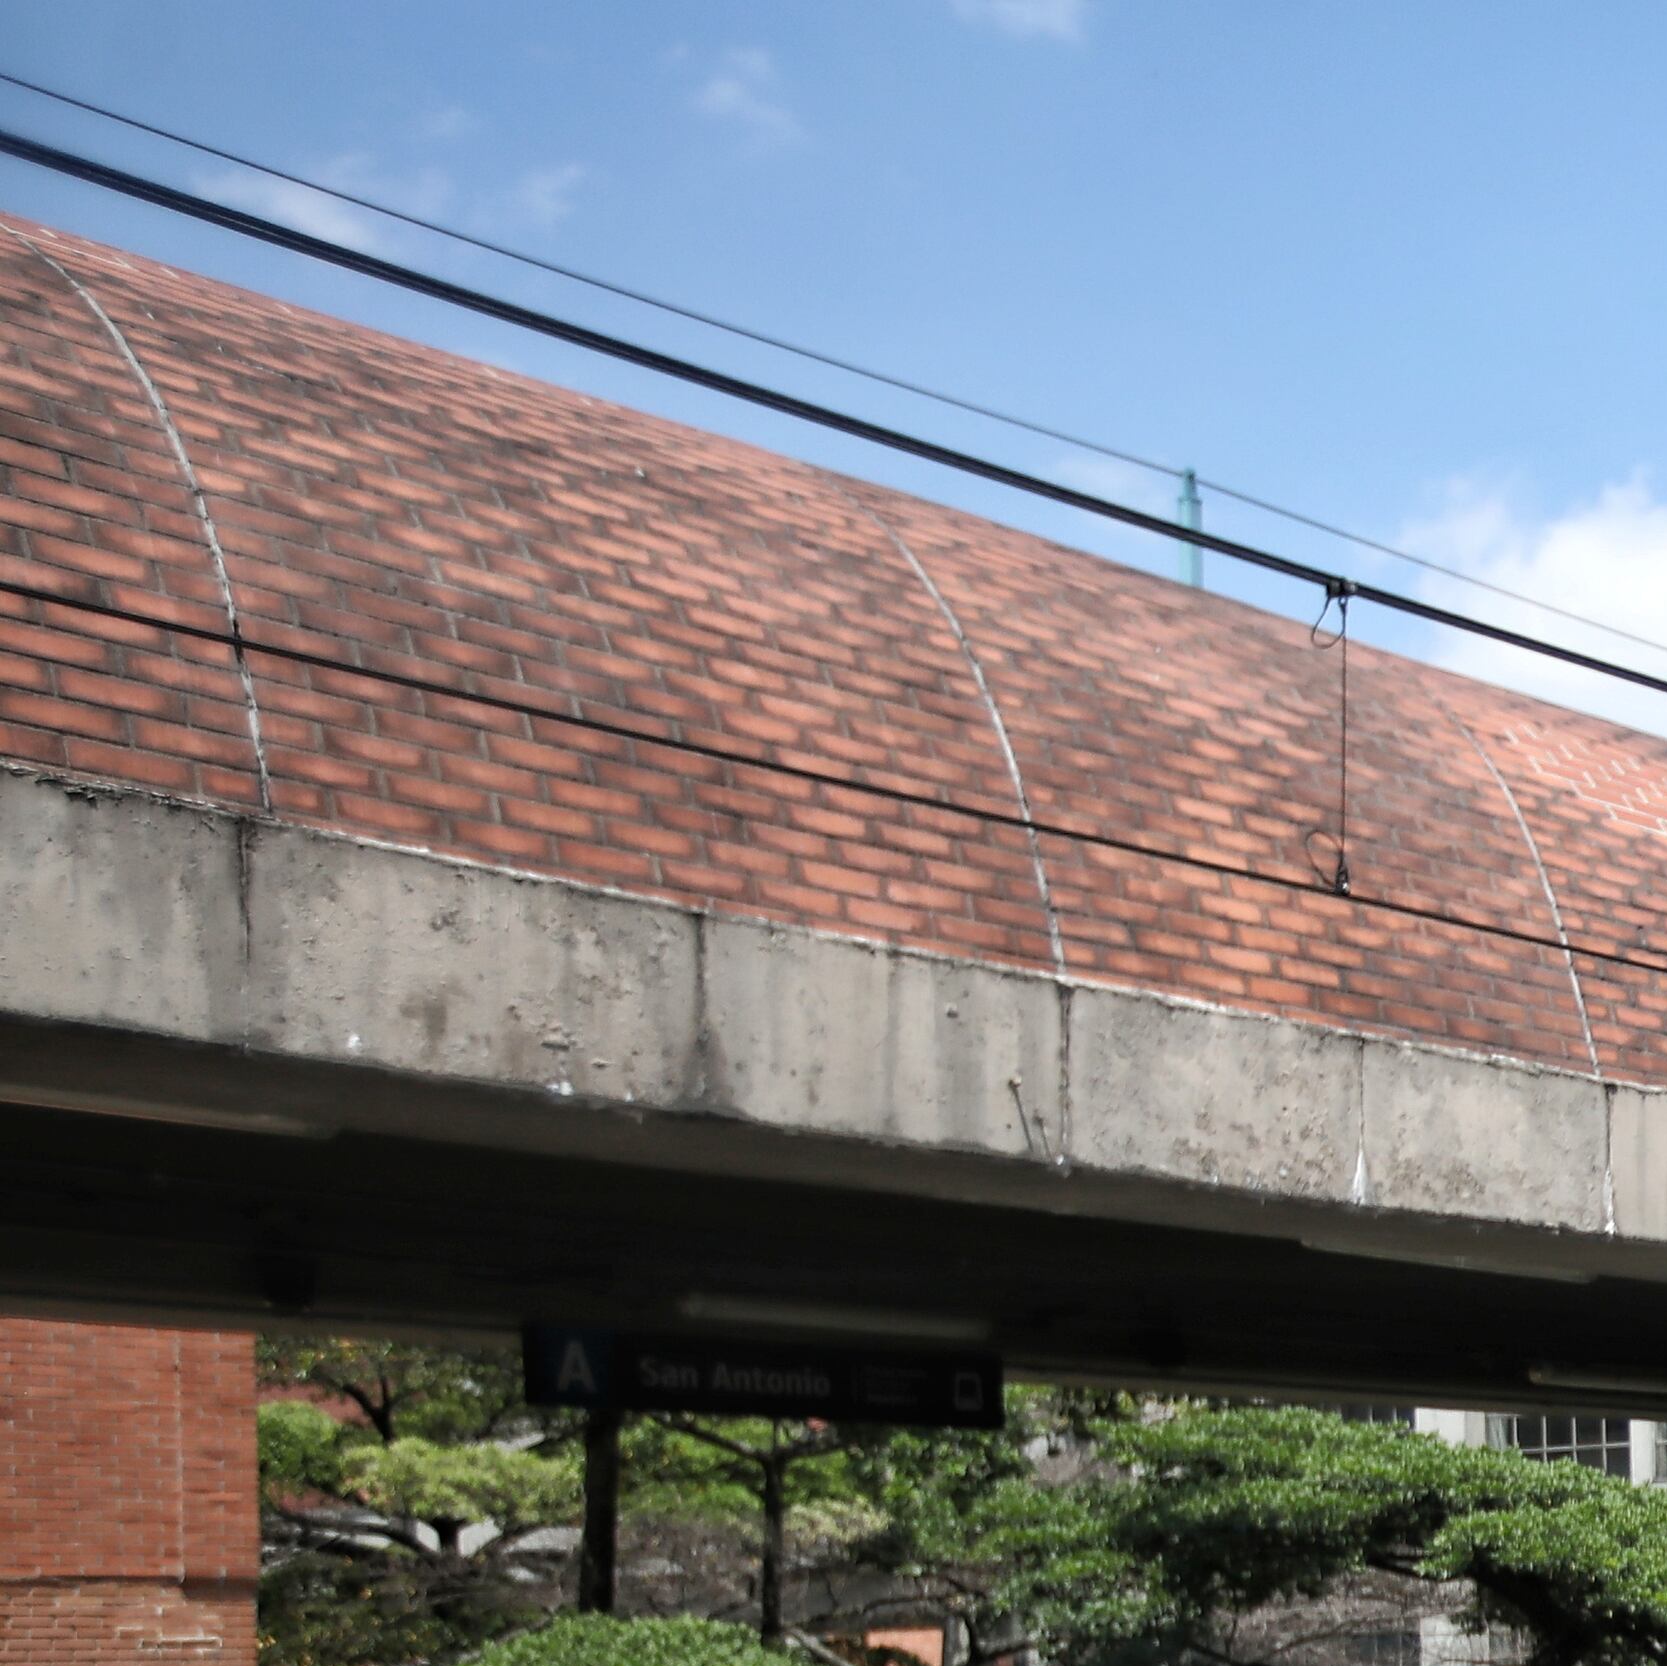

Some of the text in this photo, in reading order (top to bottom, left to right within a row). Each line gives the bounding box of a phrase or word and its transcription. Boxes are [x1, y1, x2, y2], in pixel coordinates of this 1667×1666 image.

[555, 1339, 598, 1395] A
[638, 1354, 700, 1391] San
[711, 1361, 832, 1399] Antonio
